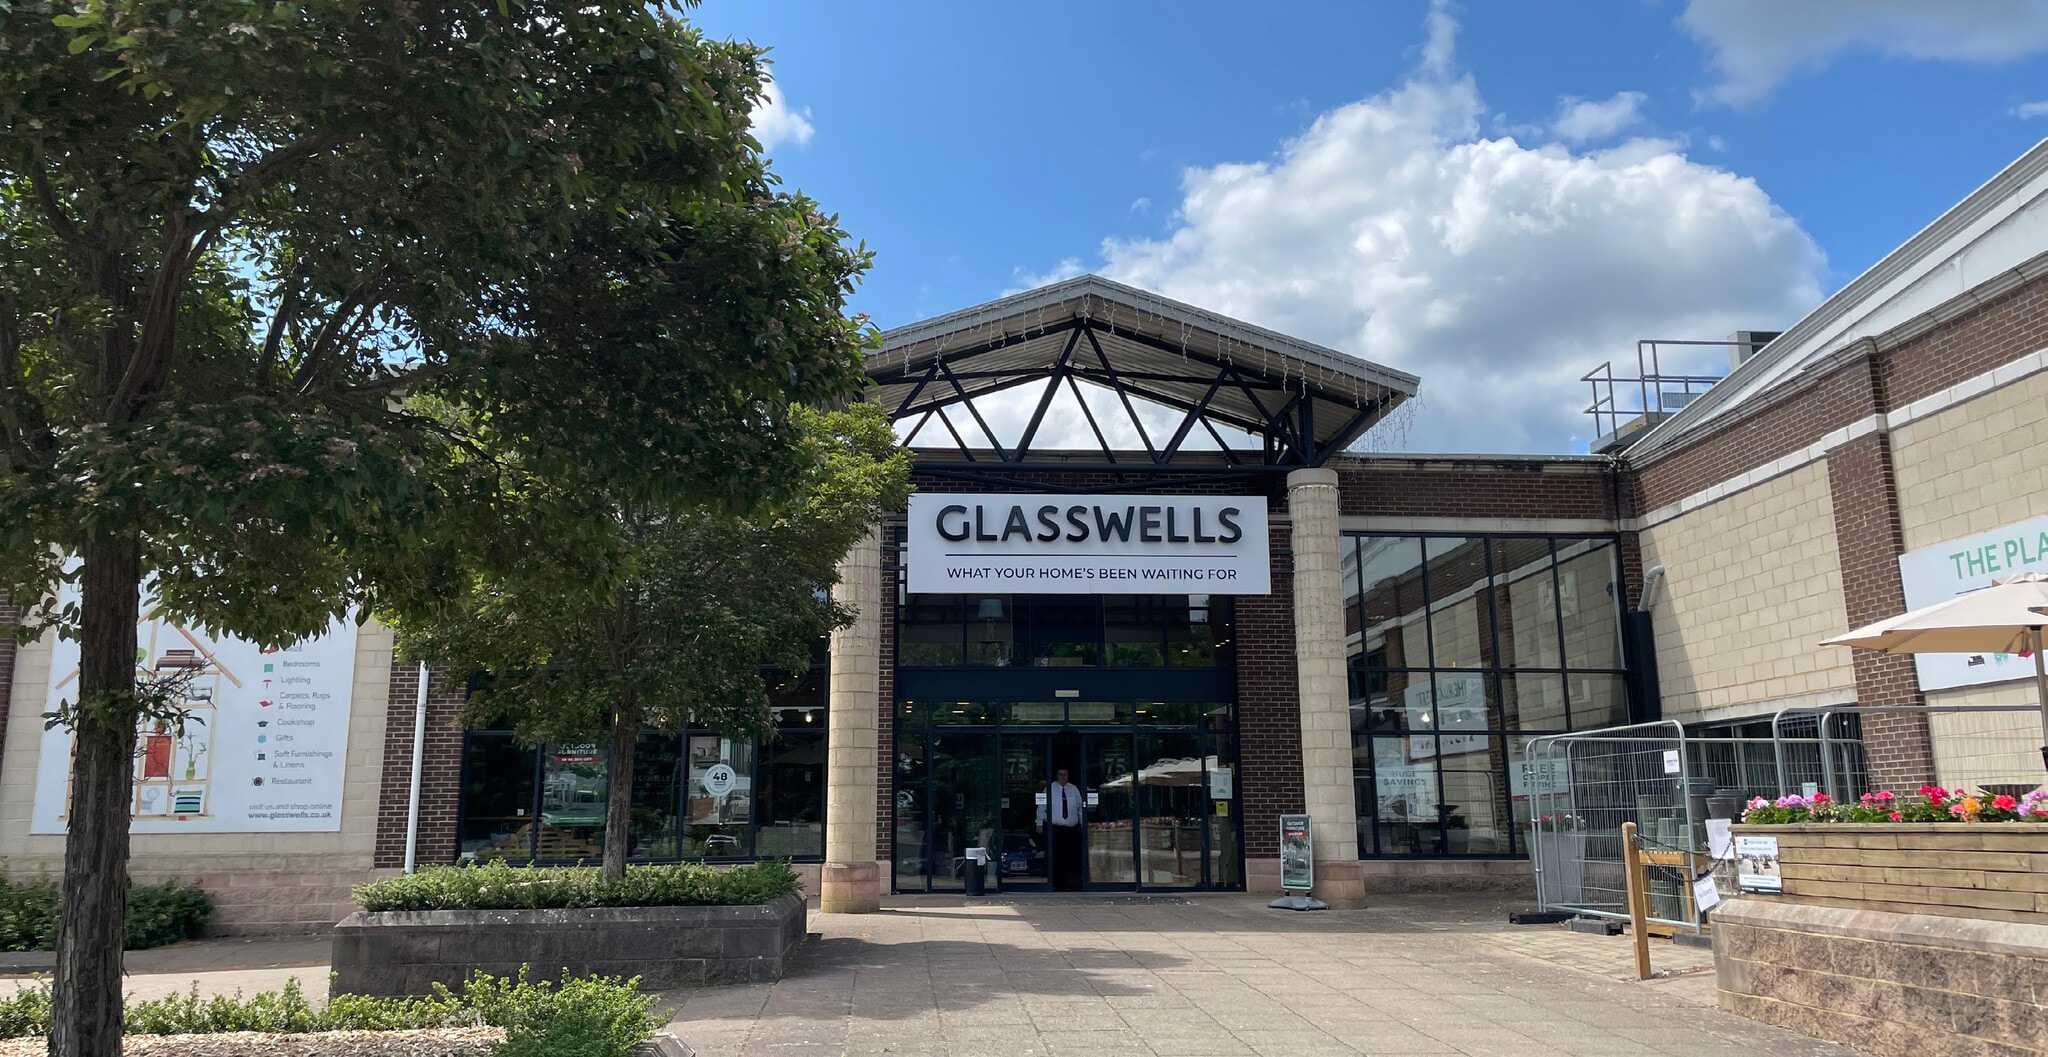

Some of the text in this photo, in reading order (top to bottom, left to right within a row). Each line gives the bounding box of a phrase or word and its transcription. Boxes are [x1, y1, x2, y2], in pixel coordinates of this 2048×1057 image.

[936, 505, 1243, 545] GLASSWELLS
[1949, 544, 2001, 579] THE
[946, 568, 1237, 580] WHAT YOUR HOME'S BEEN WAITING FOR
[281, 676, 311, 684] Lighting
[313, 692, 330, 700] Rugs
[287, 703, 316, 711] Flooring
[291, 750, 333, 758] Furnishings
[1006, 759, 1029, 774] 75
[712, 772, 728, 781] 48
[290, 803, 308, 811] shop
